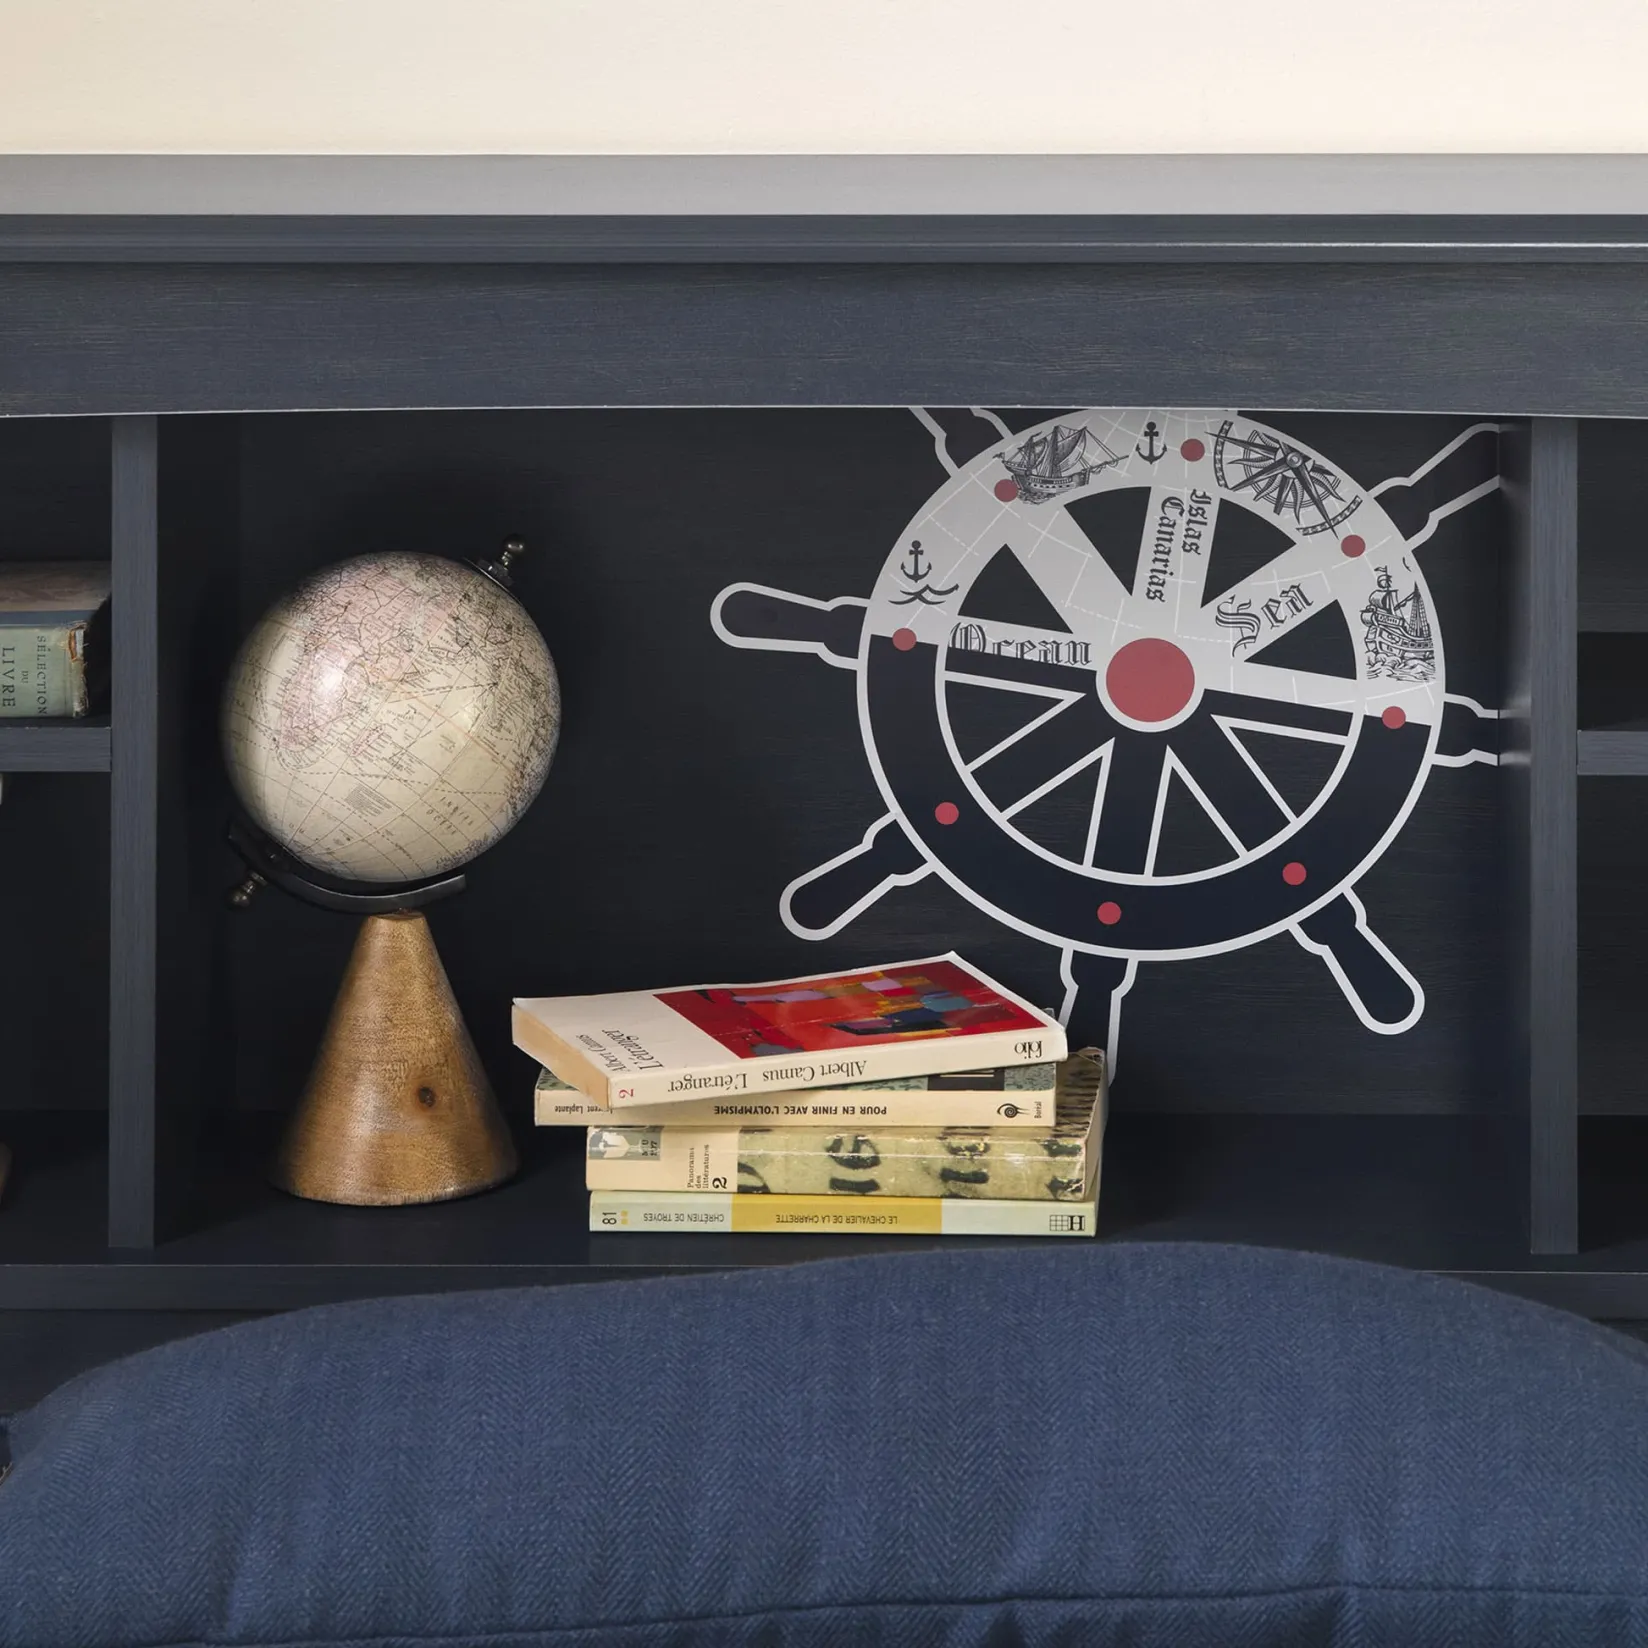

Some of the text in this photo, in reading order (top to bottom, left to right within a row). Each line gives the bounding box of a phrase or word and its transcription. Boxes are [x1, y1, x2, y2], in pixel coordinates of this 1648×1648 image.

[1182, 488, 1213, 556] Islas
[1145, 495, 1185, 603] Canarias
[1215, 582, 1316, 657] Sea
[948, 622, 1092, 666] Ocean
[2, 647, 16, 708] LIVRE
[21, 670, 29, 684] DU
[36, 635, 51, 715] SÉLECTION
[575, 1033, 629, 1072] Albert Camus
[600, 1028, 664, 1071] L'étranger
[1014, 1040, 1043, 1060] folio
[667, 1060, 867, 1093] Albert Camus L'étranger
[618, 1088, 634, 1099] 2
[554, 1103, 583, 1114] Laplante
[714, 1105, 887, 1115] POUR EN FINIR AVEC L'OLYMPISME
[712, 1177, 727, 1189] 2
[602, 1212, 618, 1225] 81
[643, 1213, 725, 1224] CHRÉTIEN DE TROYES
[776, 1215, 898, 1224] LE CHEVALIER DE LA CHARRETTE
